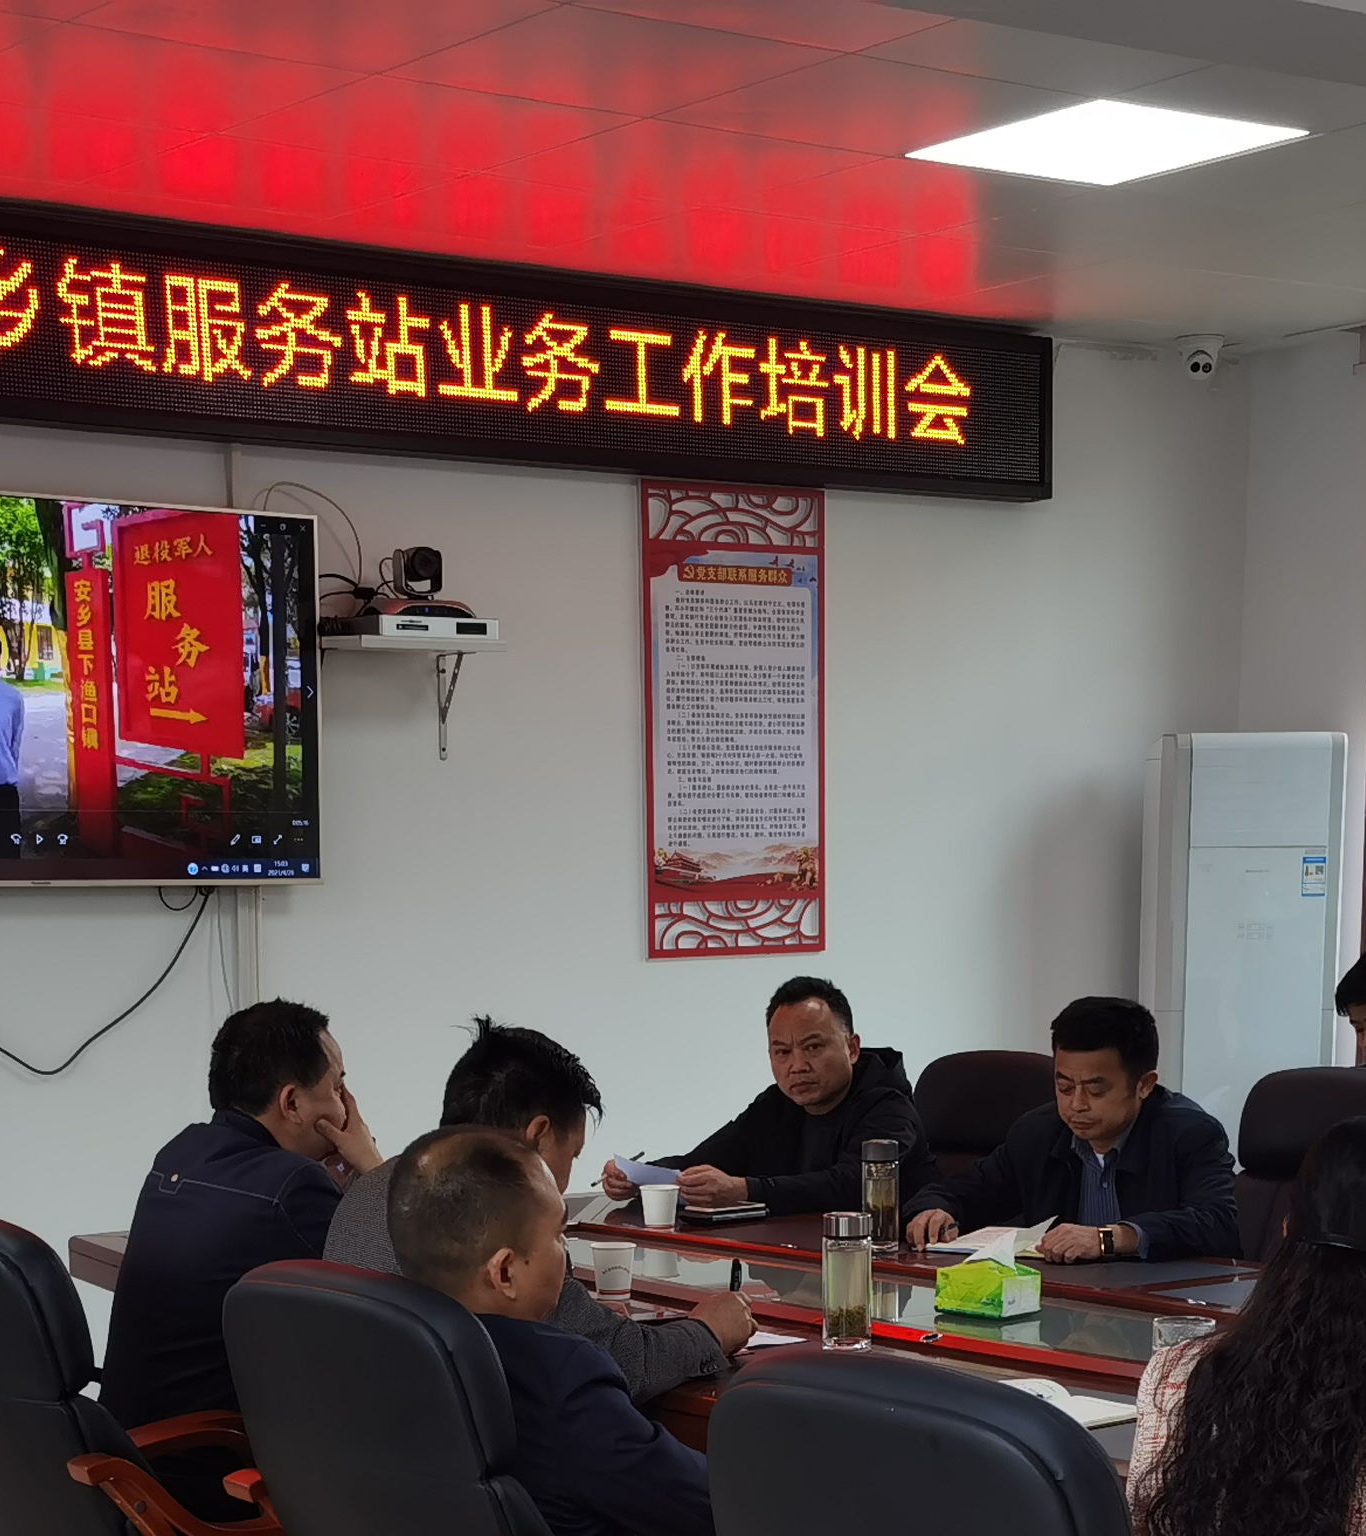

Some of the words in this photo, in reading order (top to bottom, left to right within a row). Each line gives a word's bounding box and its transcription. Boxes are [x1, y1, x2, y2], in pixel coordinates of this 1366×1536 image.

[133, 533, 213, 565] 退役军人
[73, 579, 99, 750] 安乡县下渔口镇
[144, 578, 211, 704] 服务站
